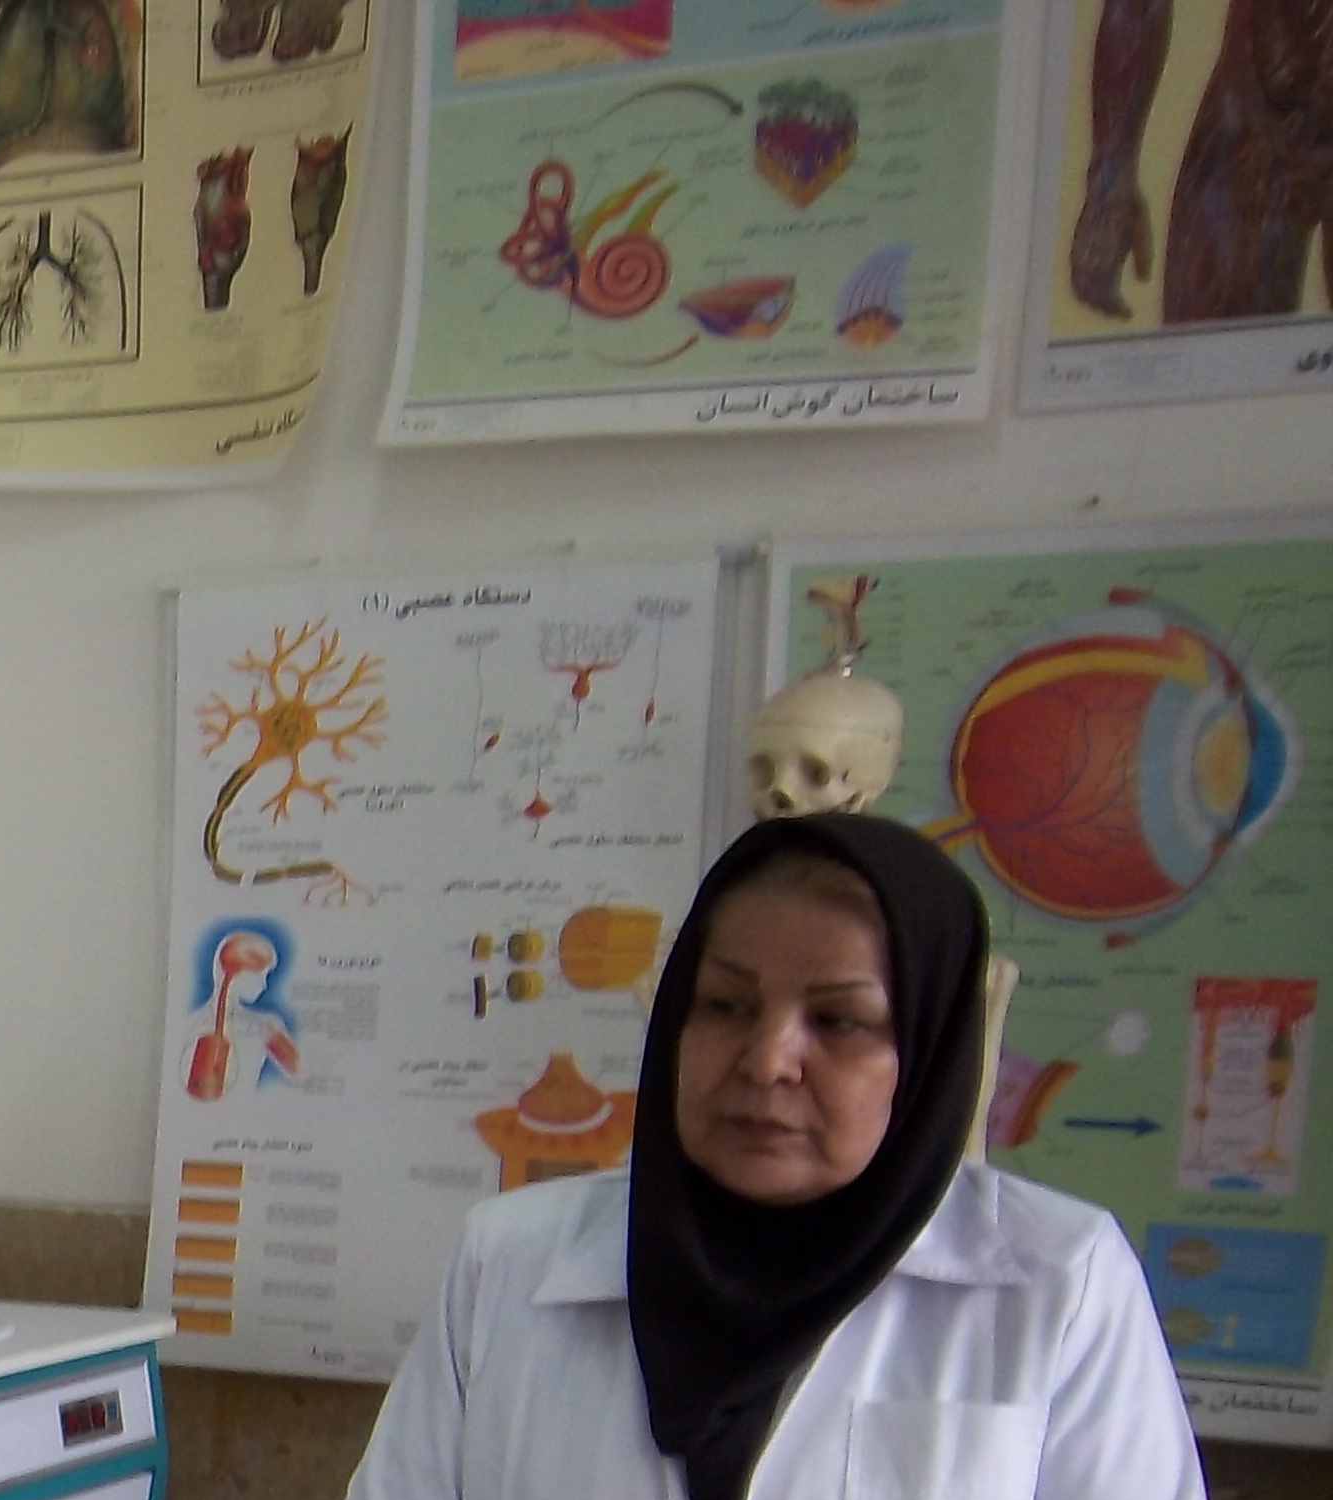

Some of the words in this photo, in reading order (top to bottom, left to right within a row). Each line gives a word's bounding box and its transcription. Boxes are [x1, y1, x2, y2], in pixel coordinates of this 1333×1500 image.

[696, 391, 770, 422] انسان
[771, 384, 839, 418] گوش
[843, 383, 960, 416] ساختمان
[395, 592, 453, 619] عصبی
[462, 585, 532, 606] دستگاه
